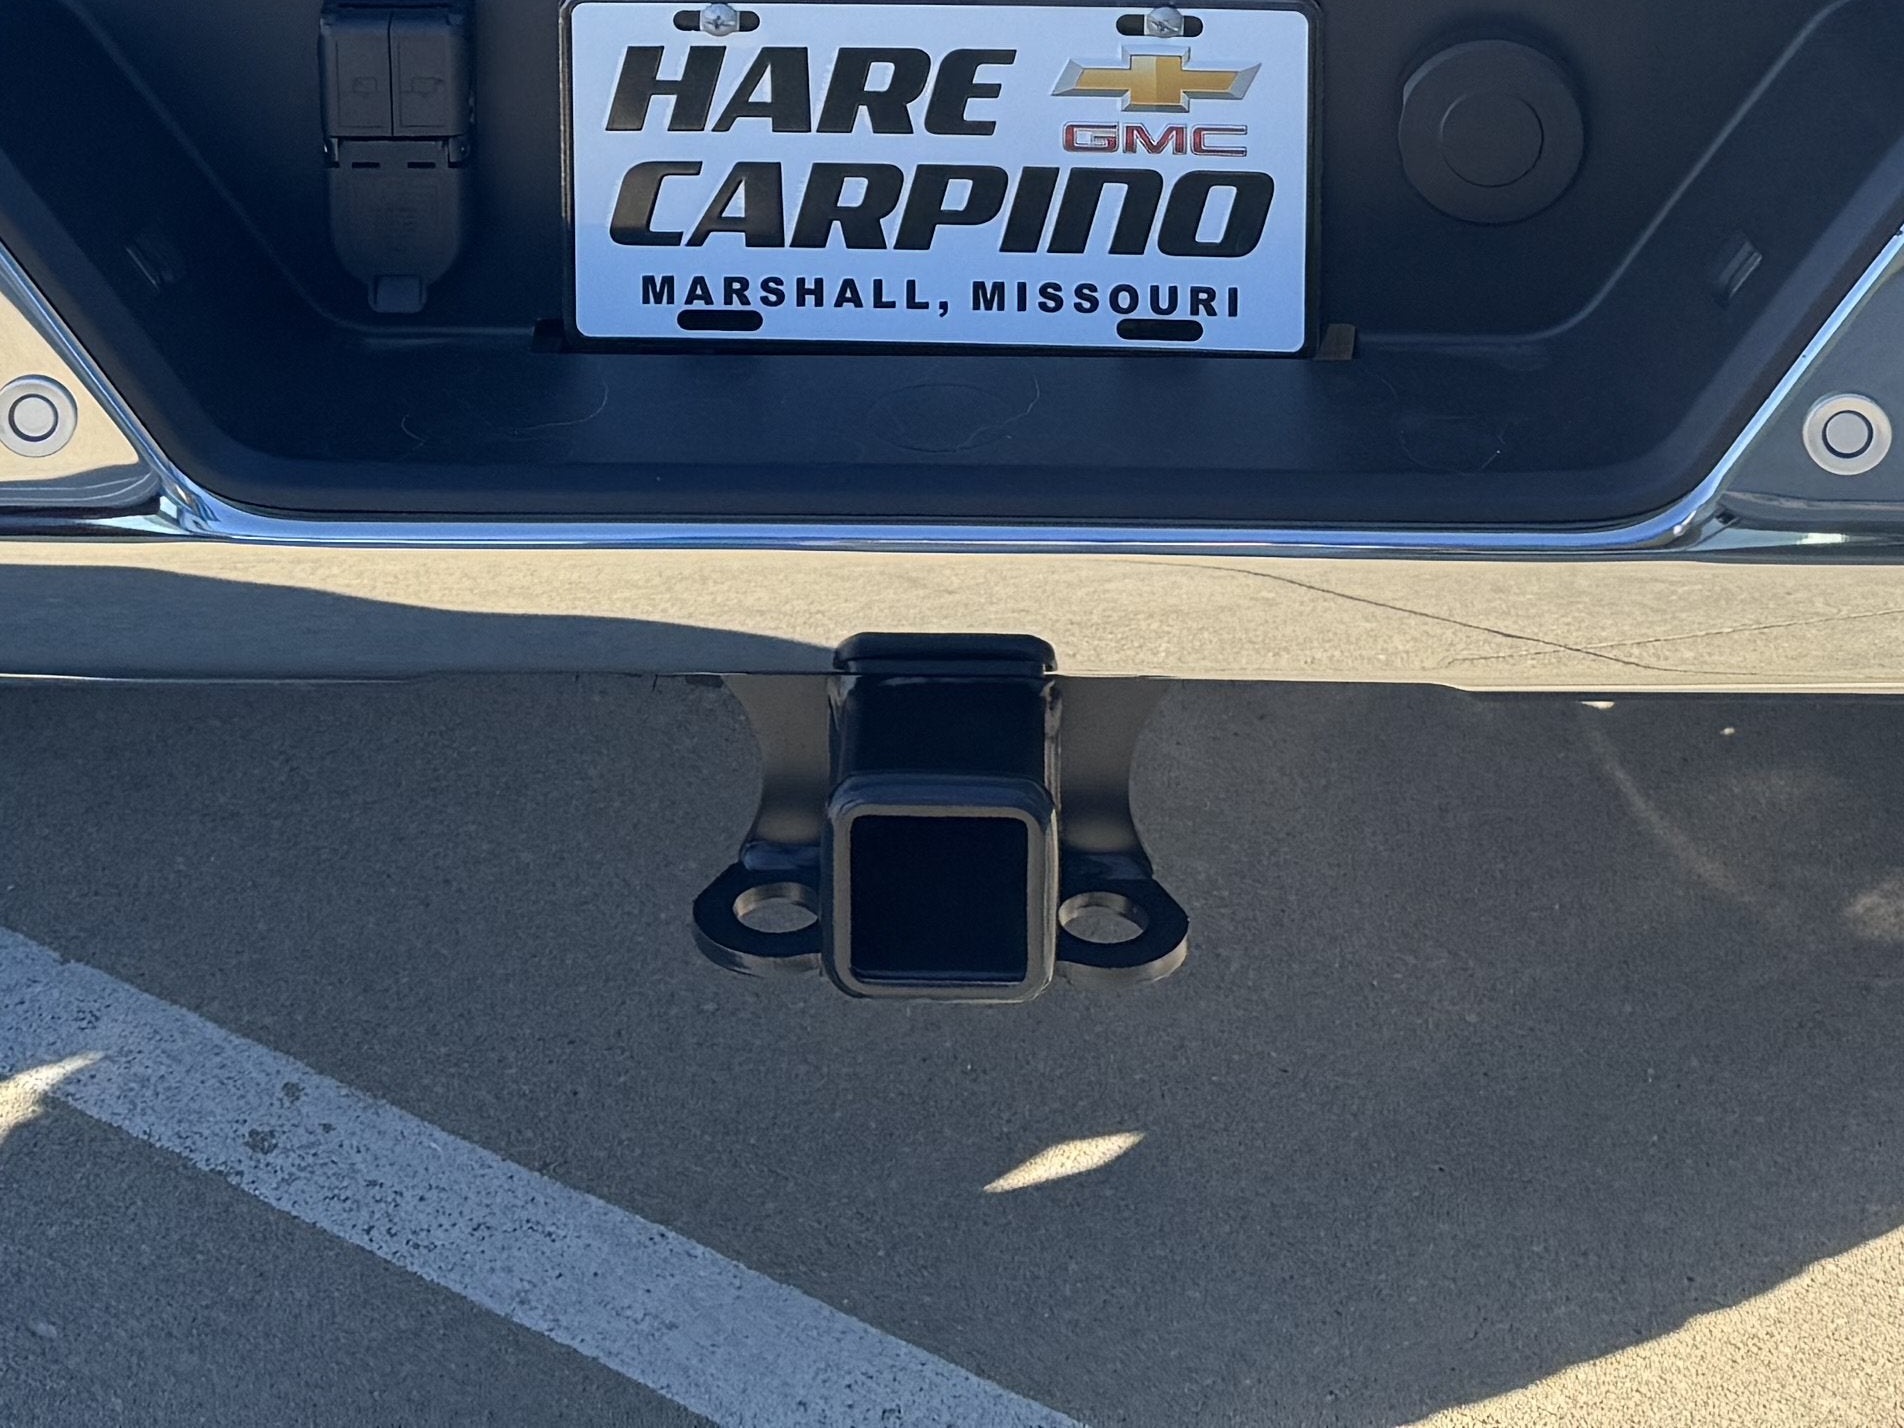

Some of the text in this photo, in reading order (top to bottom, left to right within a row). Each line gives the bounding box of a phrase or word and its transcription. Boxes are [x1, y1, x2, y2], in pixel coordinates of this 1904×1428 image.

[605, 45, 1017, 135] HARE
[1062, 121, 1248, 157] GMC
[609, 161, 1274, 258] CARPINO
[641, 275, 1239, 318] MARSHALL, MISSOURI
